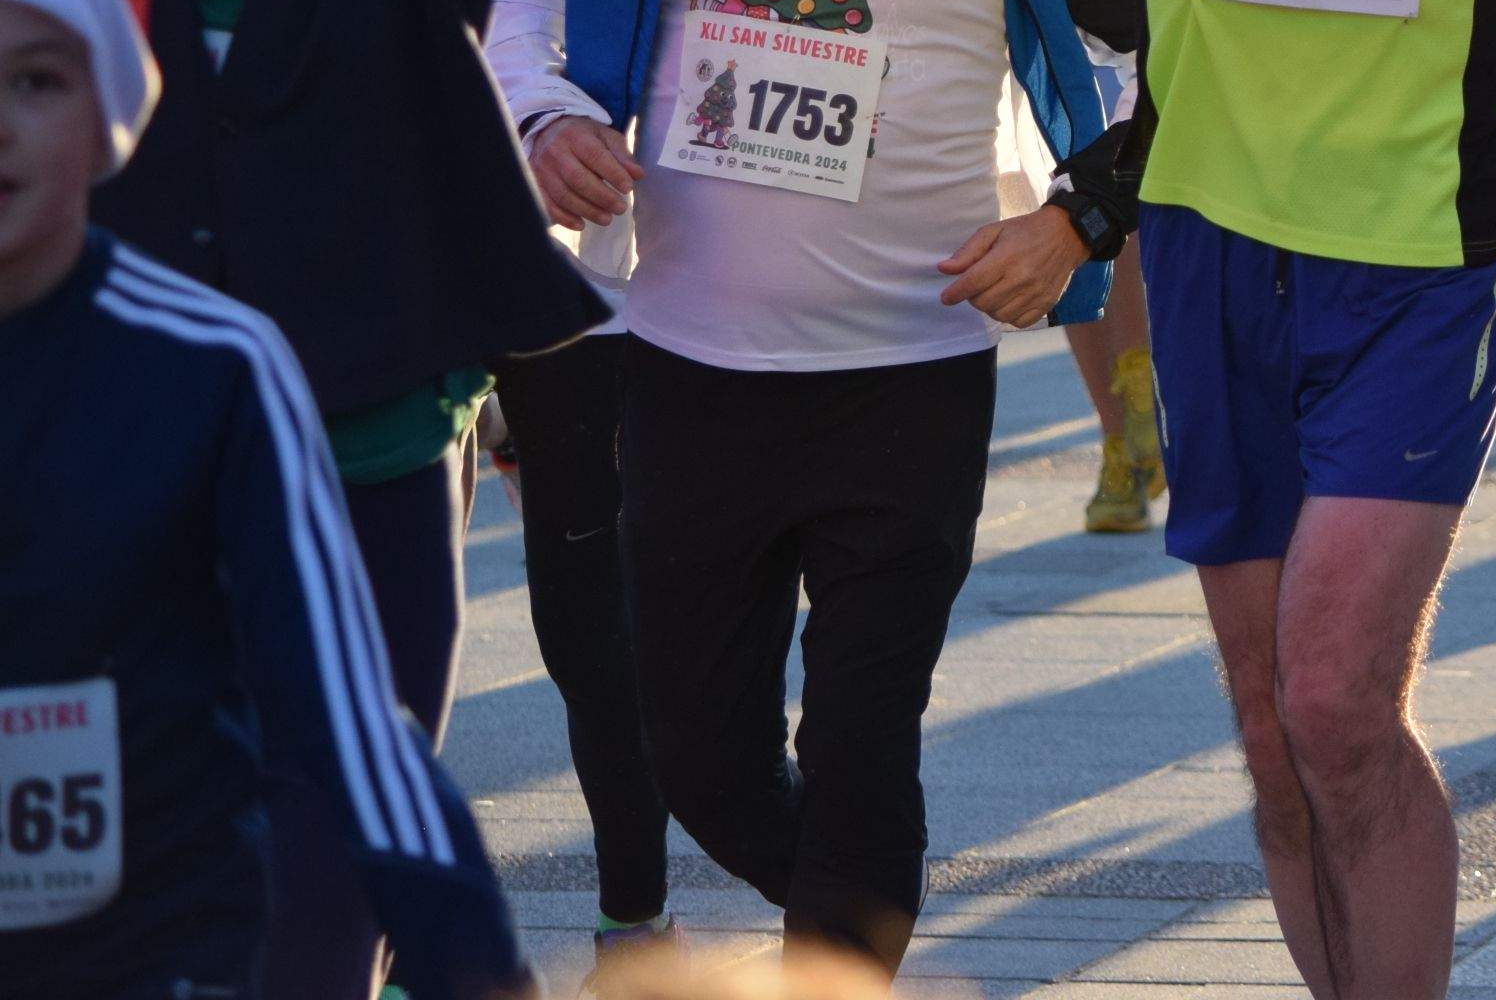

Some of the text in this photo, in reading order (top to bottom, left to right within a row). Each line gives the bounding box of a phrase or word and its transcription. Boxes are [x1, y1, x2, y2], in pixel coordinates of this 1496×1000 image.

[700, 21, 869, 67] XLI SAN SILVESTRE
[748, 78, 858, 147] 1753
[731, 139, 810, 166] PONTEVEDRA
[814, 155, 848, 172] 2024
[0, 701, 88, 736] ESTRE
[0, 772, 107, 856] 65
